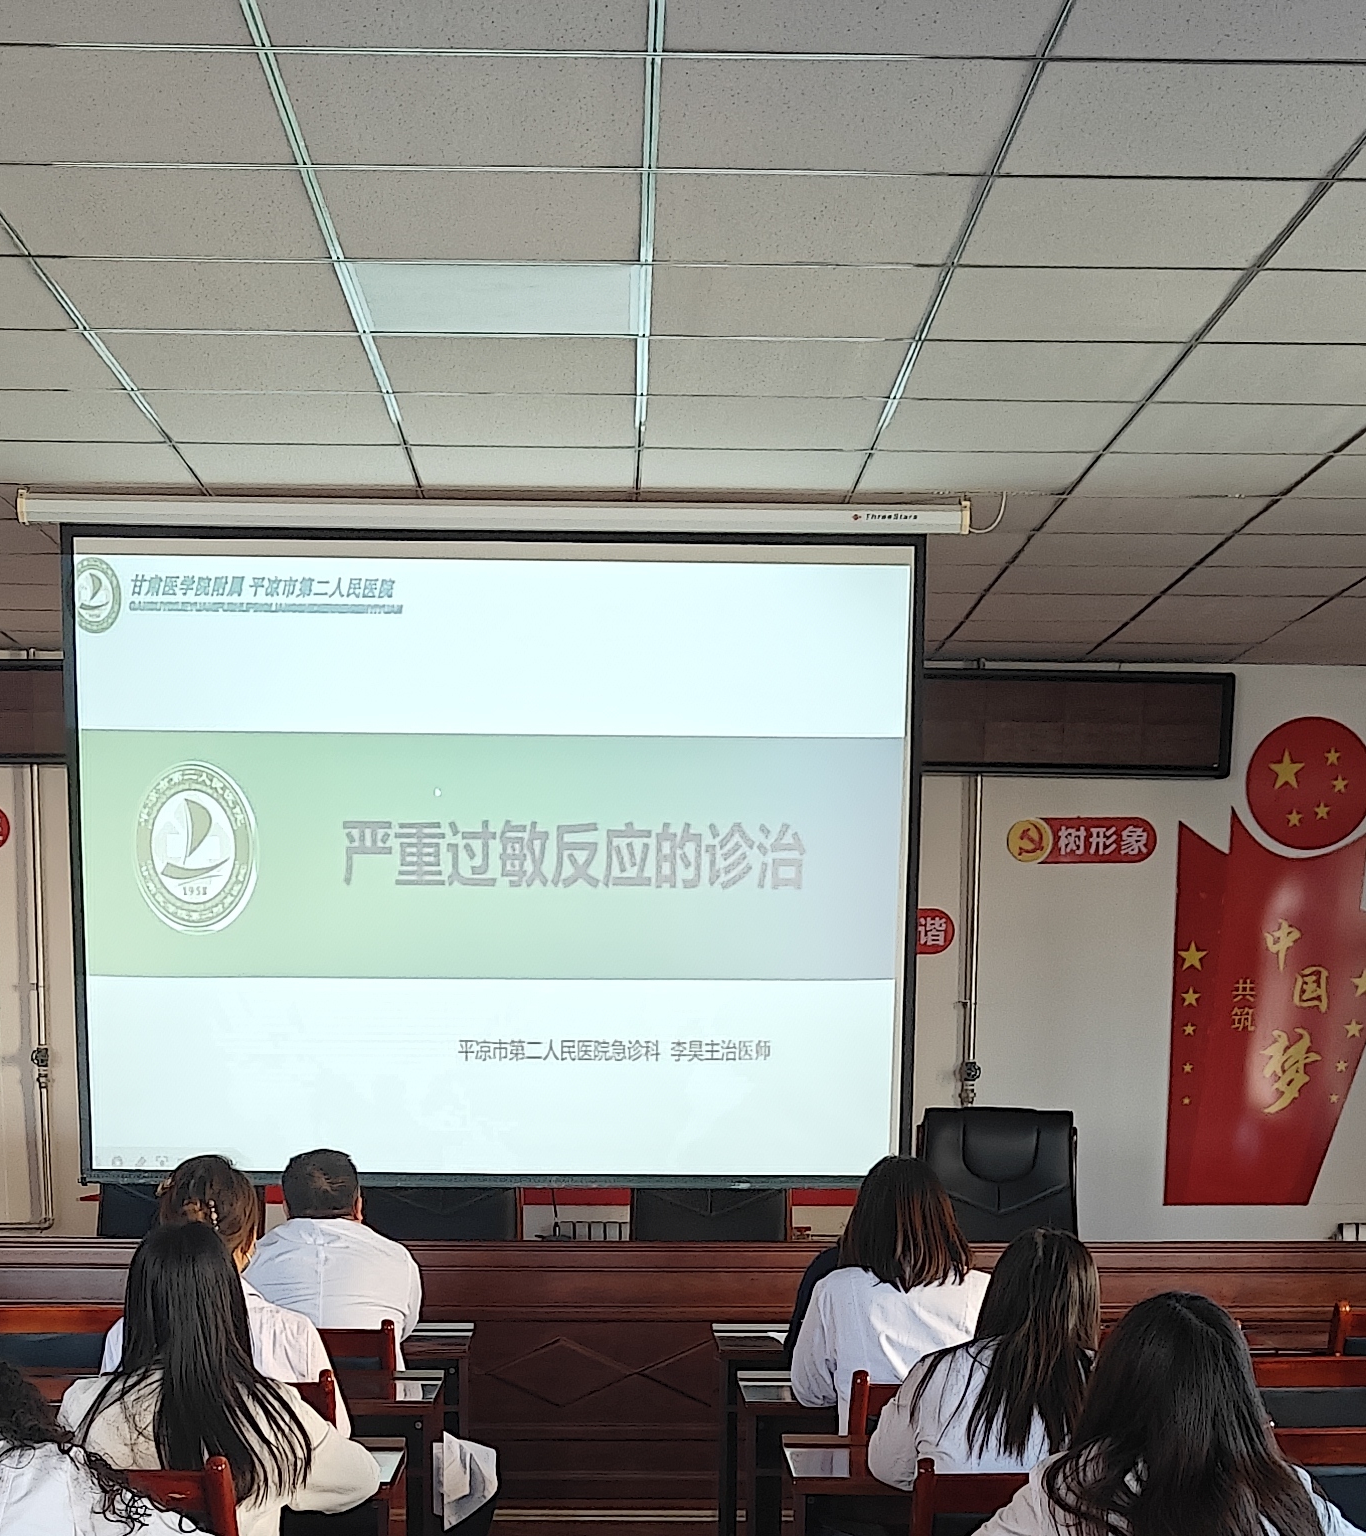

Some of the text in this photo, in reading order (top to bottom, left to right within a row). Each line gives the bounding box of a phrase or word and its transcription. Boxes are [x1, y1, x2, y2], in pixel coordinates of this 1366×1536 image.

[865, 513, 918, 521] ThreeStars
[131, 574, 396, 600] 甘肃医学院附属 平凉市第二人民医院
[343, 818, 805, 891] 严重过敏反应的诊治
[1058, 825, 1148, 855] 树形象
[1231, 978, 1257, 1032] 共筑
[1259, 918, 1331, 1114] 中国梦
[457, 1039, 661, 1062] 平凉市第二人民医院急诊科
